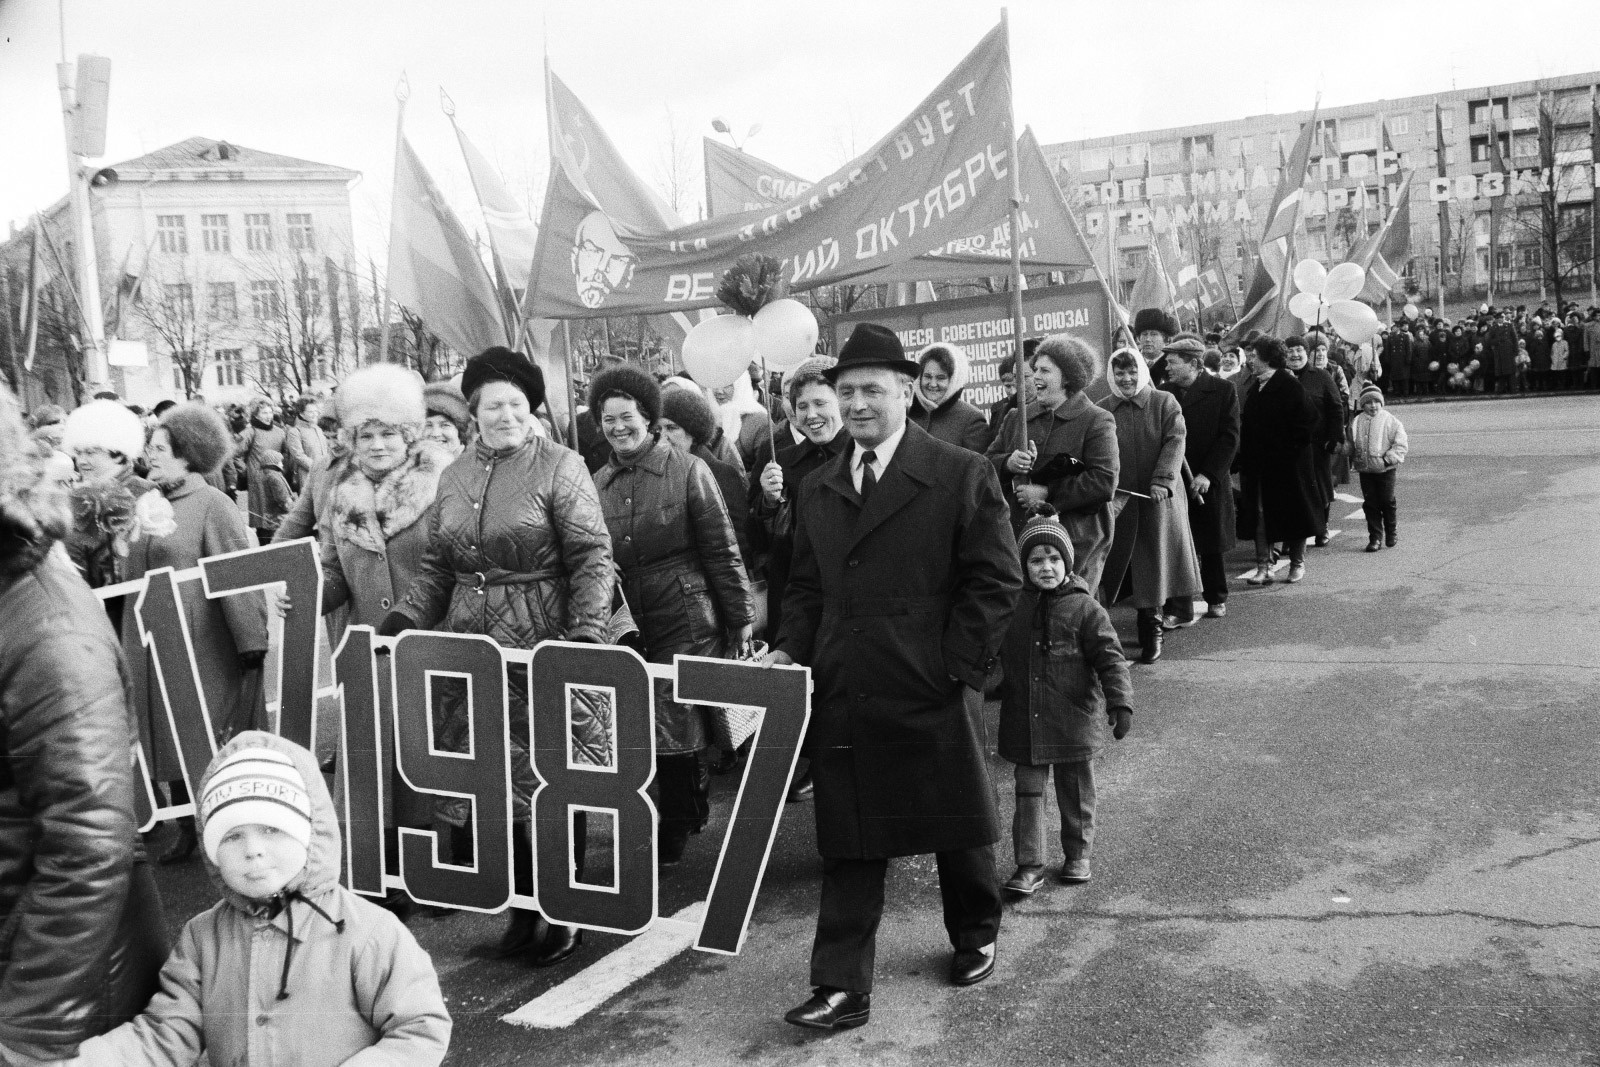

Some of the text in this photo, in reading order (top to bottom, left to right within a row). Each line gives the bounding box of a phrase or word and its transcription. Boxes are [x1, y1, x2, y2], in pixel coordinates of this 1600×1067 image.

[1074, 165, 1269, 207] РОГРАММА
[664, 144, 1008, 303] ВЕИЙ ОКТЯБРЬ
[1085, 198, 1251, 235] ОГРАММА
[1033, 308, 1090, 332] СОЮЗА!
[239, 780, 299, 803] SPORT
[331, 624, 812, 956] 1987
